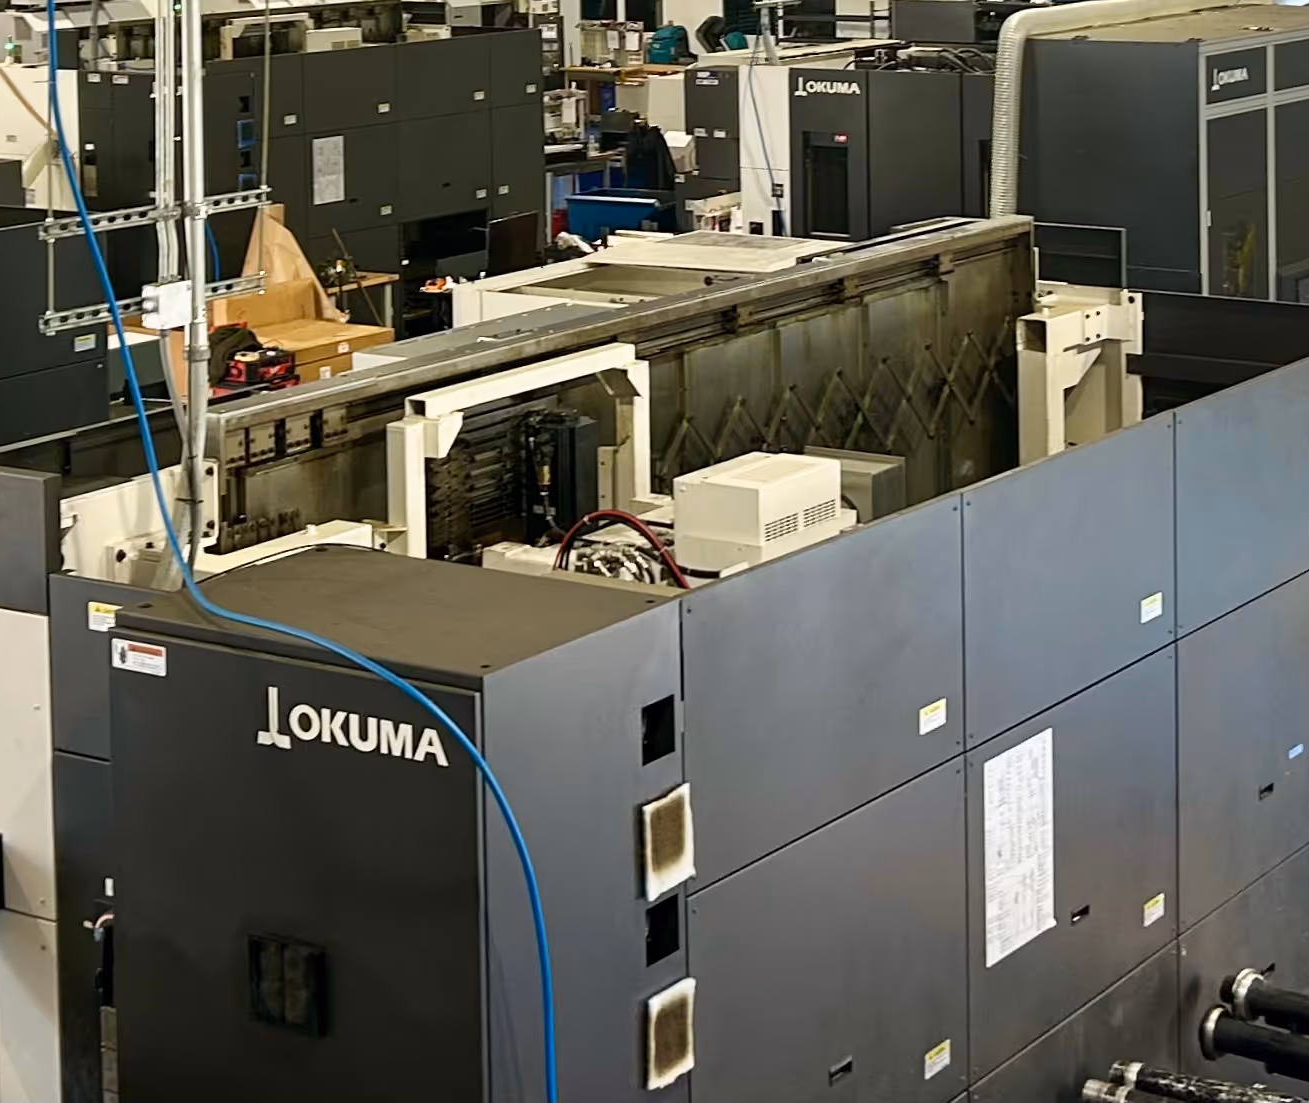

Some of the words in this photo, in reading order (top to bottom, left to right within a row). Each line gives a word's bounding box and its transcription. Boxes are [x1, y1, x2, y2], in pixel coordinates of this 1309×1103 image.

[1218, 67, 1249, 85] OKUMA
[806, 80, 861, 95] OKUMA
[288, 703, 450, 767] OKUMA
